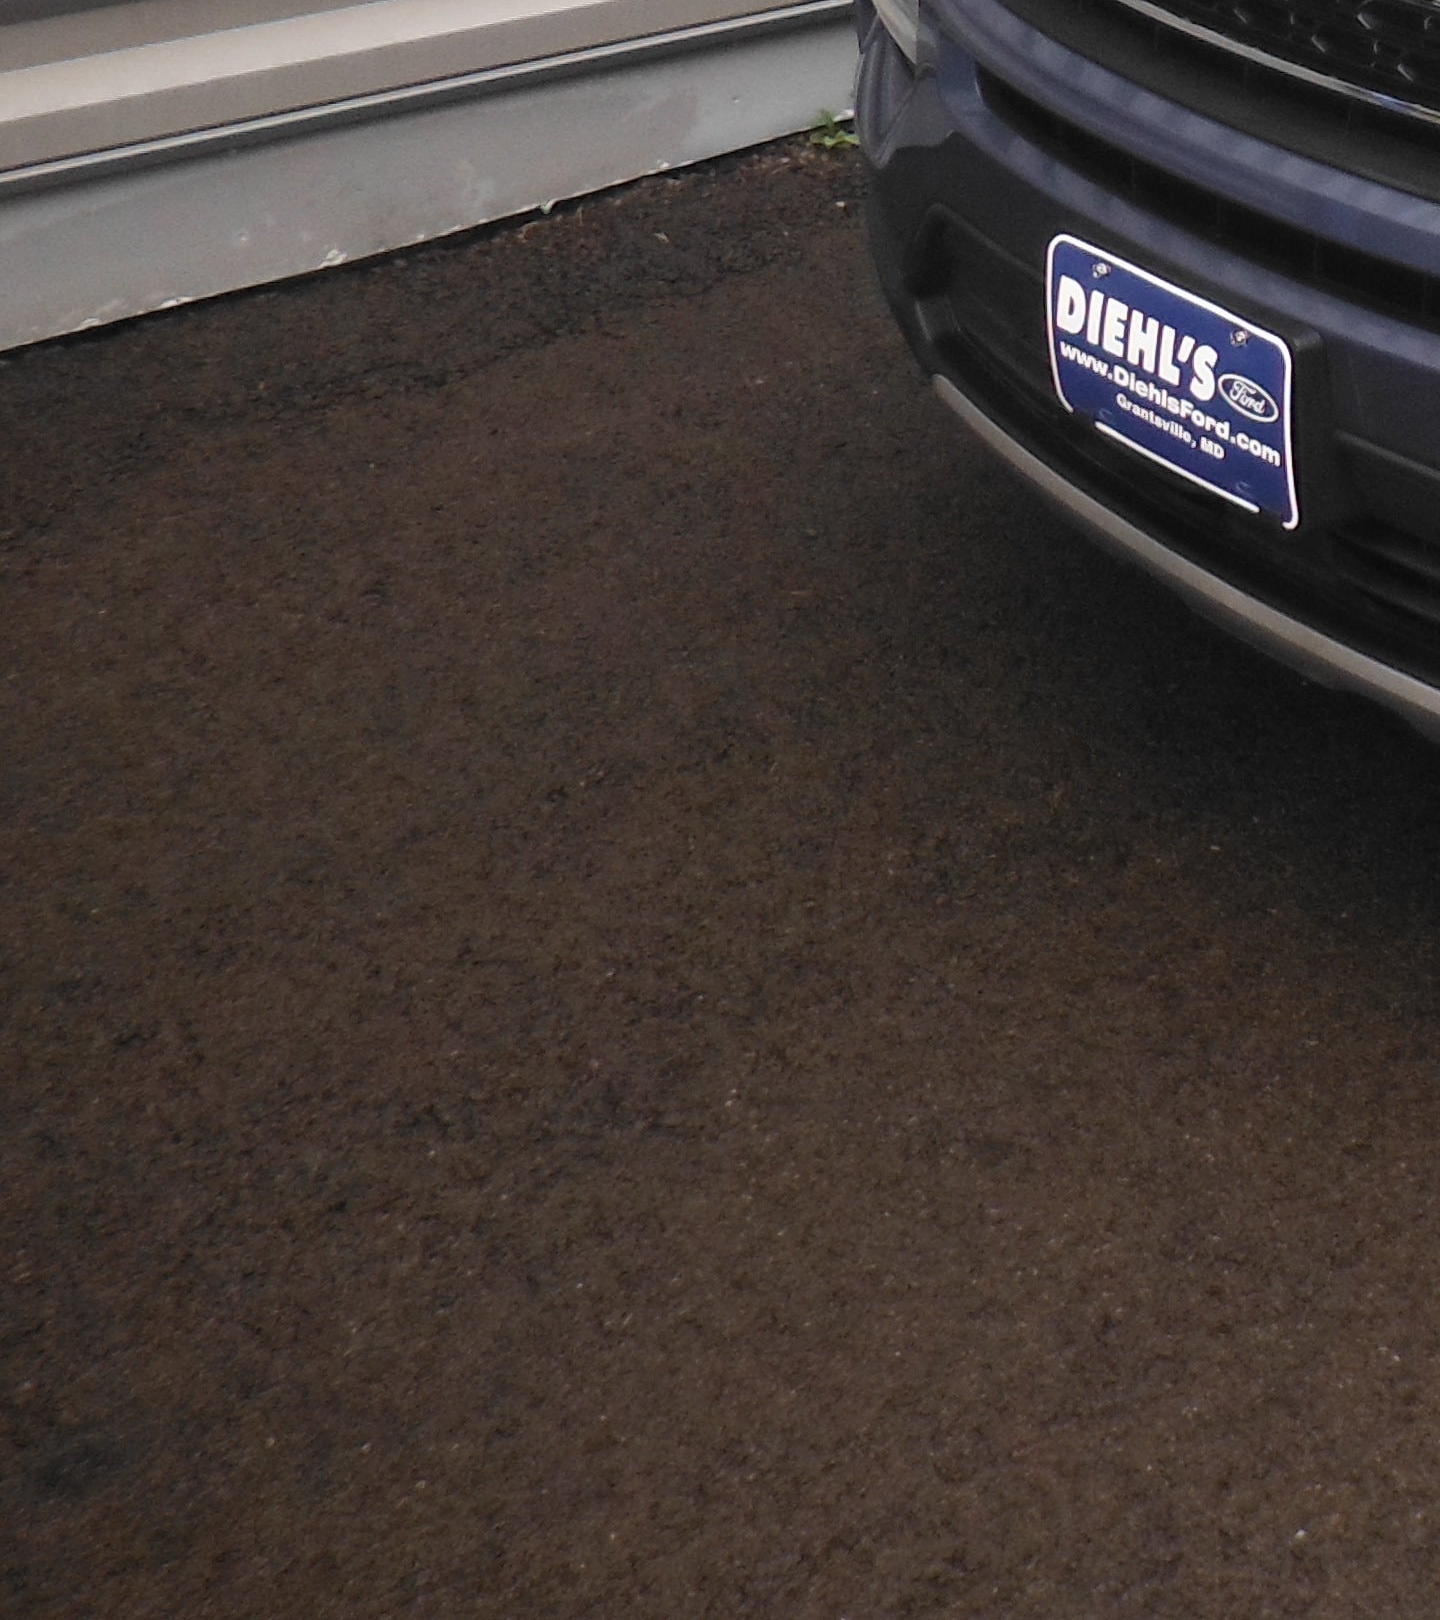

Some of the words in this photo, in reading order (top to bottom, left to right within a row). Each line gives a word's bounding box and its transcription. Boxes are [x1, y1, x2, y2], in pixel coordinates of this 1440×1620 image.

[1056, 274, 1219, 401] DIEHL'S
[1060, 340, 1281, 468] www.DiehlsFord.com
[1115, 392, 1197, 449] Grantsville,
[1200, 435, 1225, 460] MD
[1229, 379, 1267, 415] Ford
